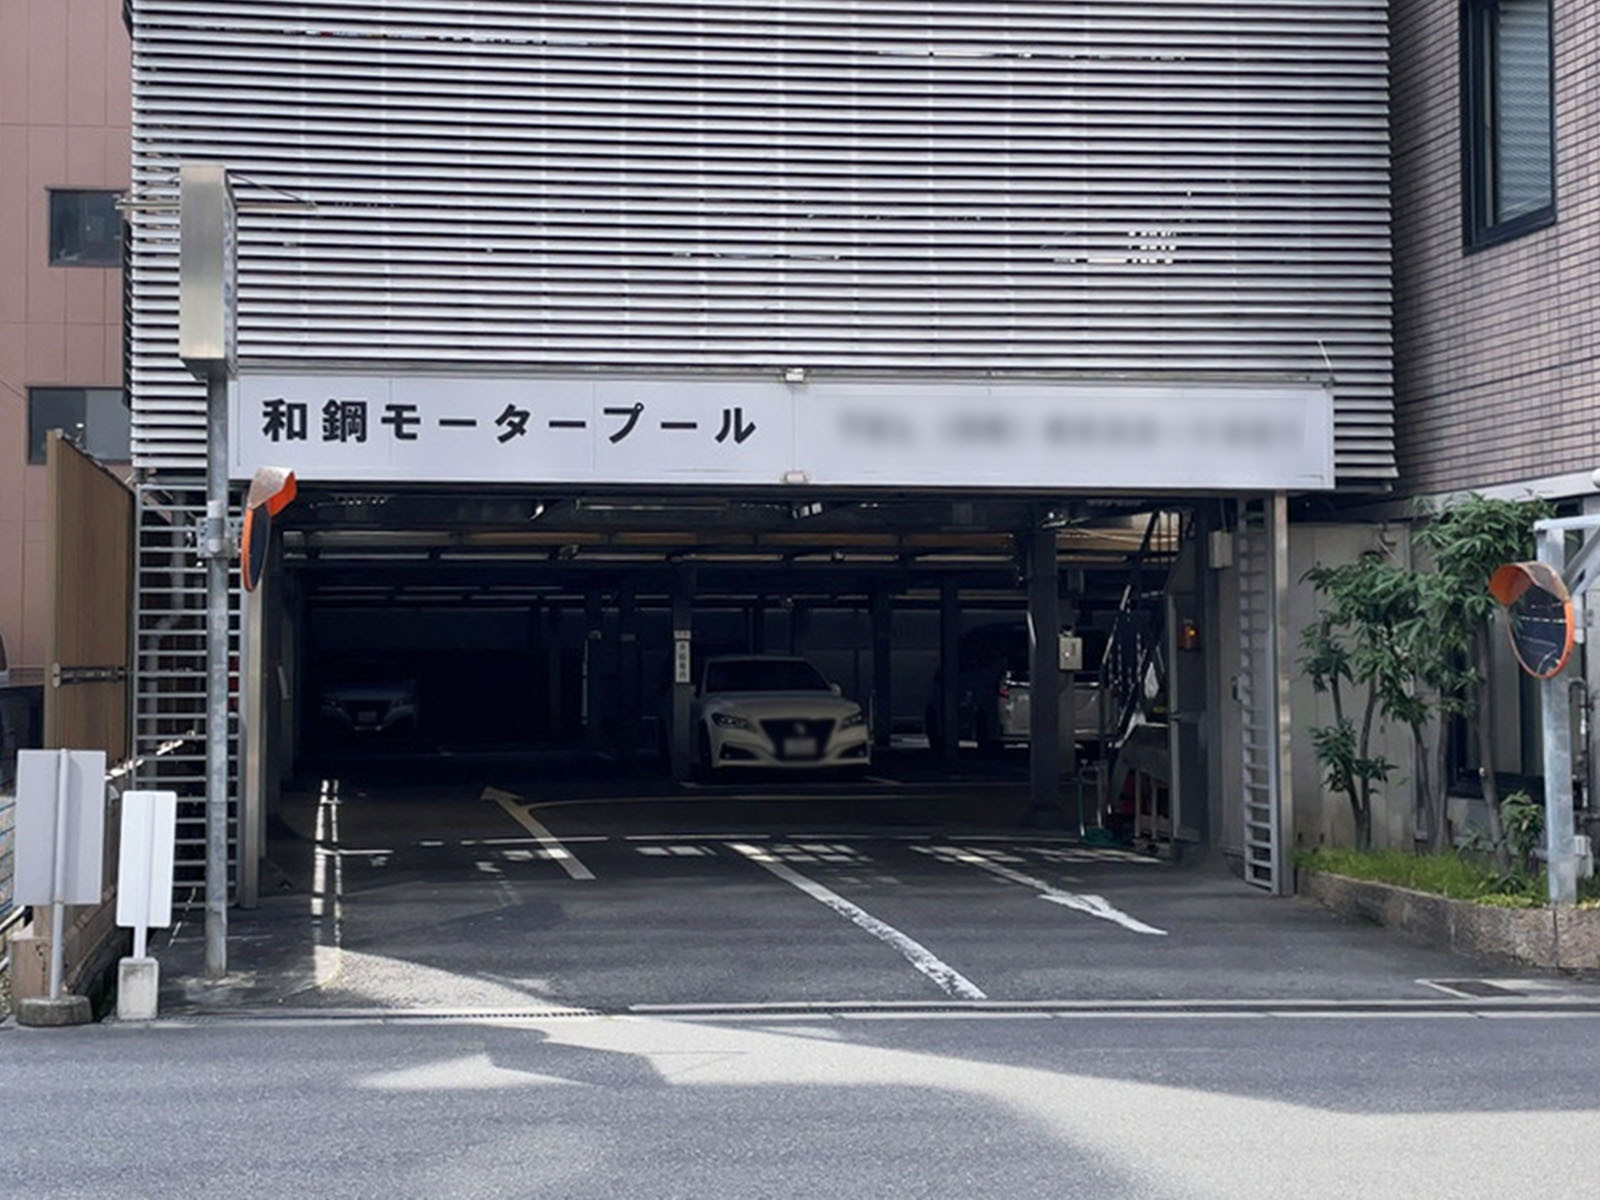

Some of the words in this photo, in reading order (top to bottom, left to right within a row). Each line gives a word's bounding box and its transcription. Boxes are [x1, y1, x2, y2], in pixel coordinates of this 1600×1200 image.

[262, 398, 756, 444] 和鋼モータープール
